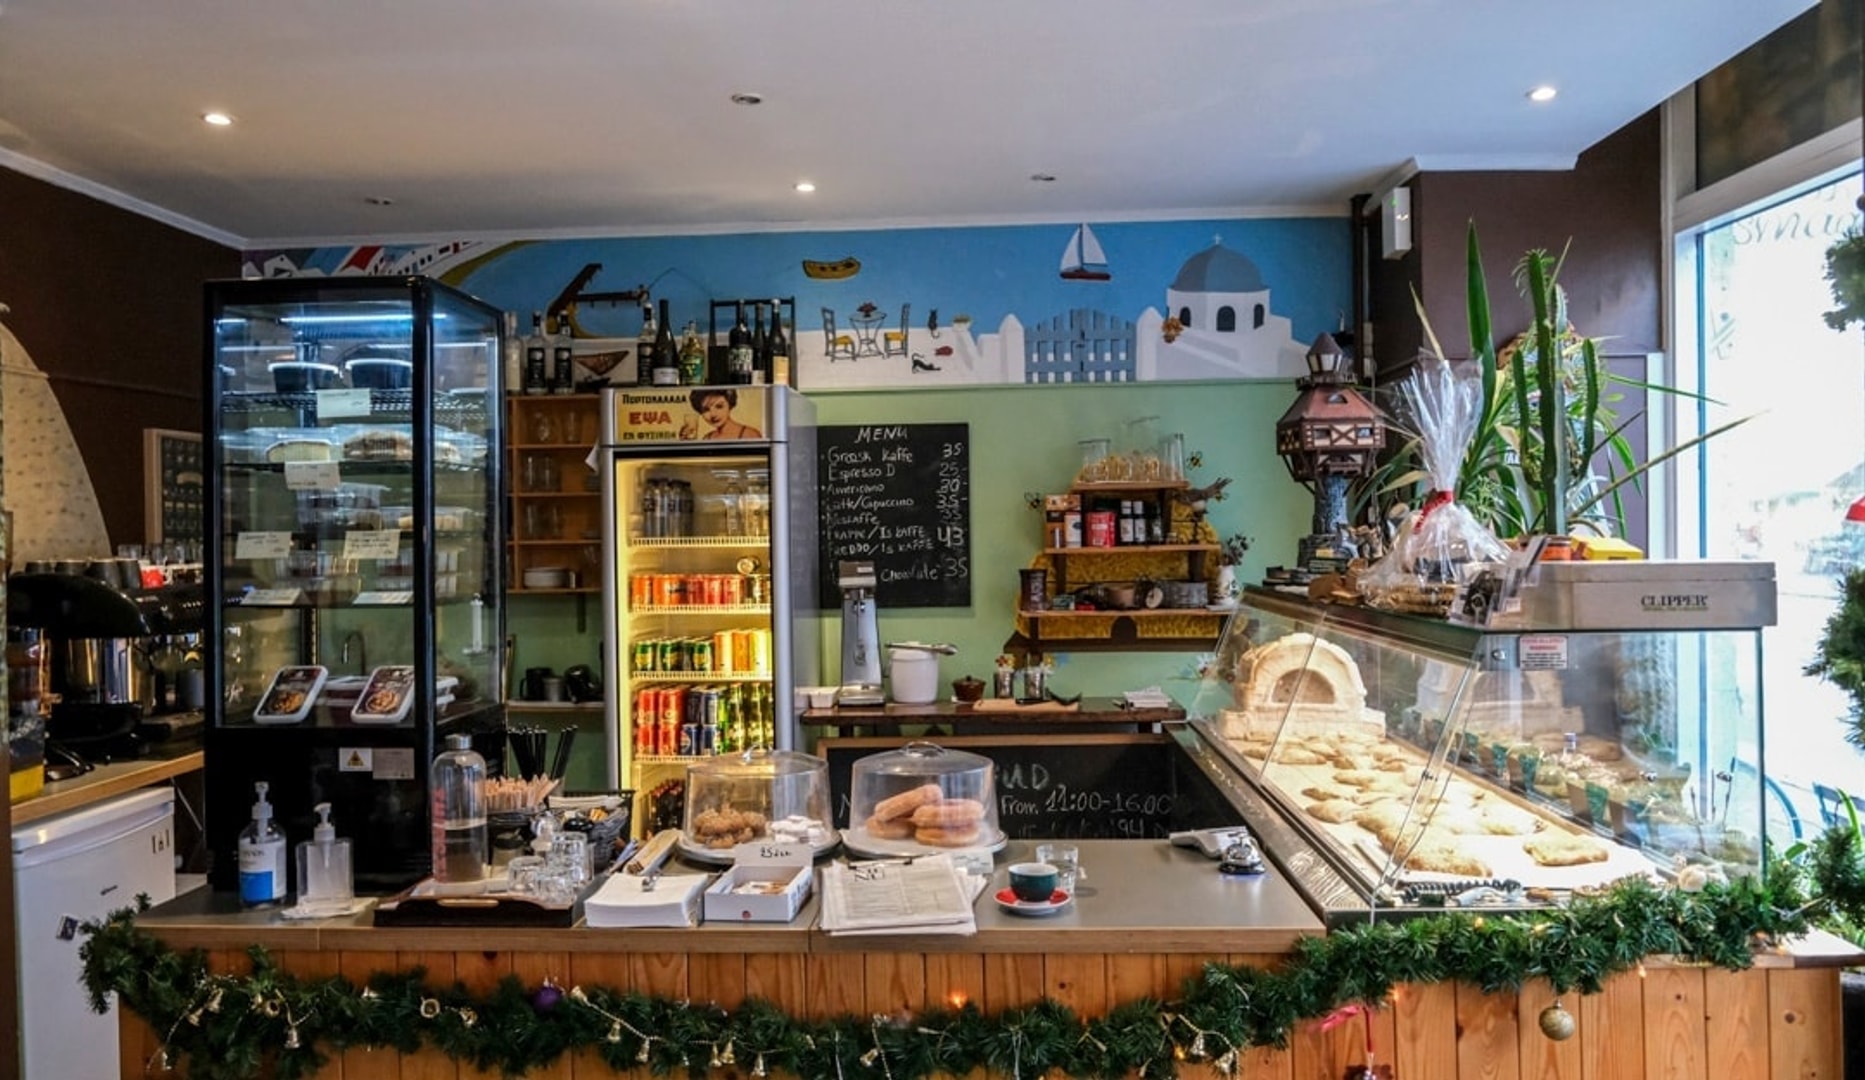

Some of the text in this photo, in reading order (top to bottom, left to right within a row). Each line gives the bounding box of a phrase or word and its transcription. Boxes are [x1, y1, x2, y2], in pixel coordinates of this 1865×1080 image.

[629, 411, 672, 425] ΕΨΑ
[854, 426, 908, 443] MENU
[828, 464, 882, 482] Espresso
[937, 526, 964, 547] 43
[945, 557, 968, 578] 35
[1641, 595, 1708, 607] CLIPPER
